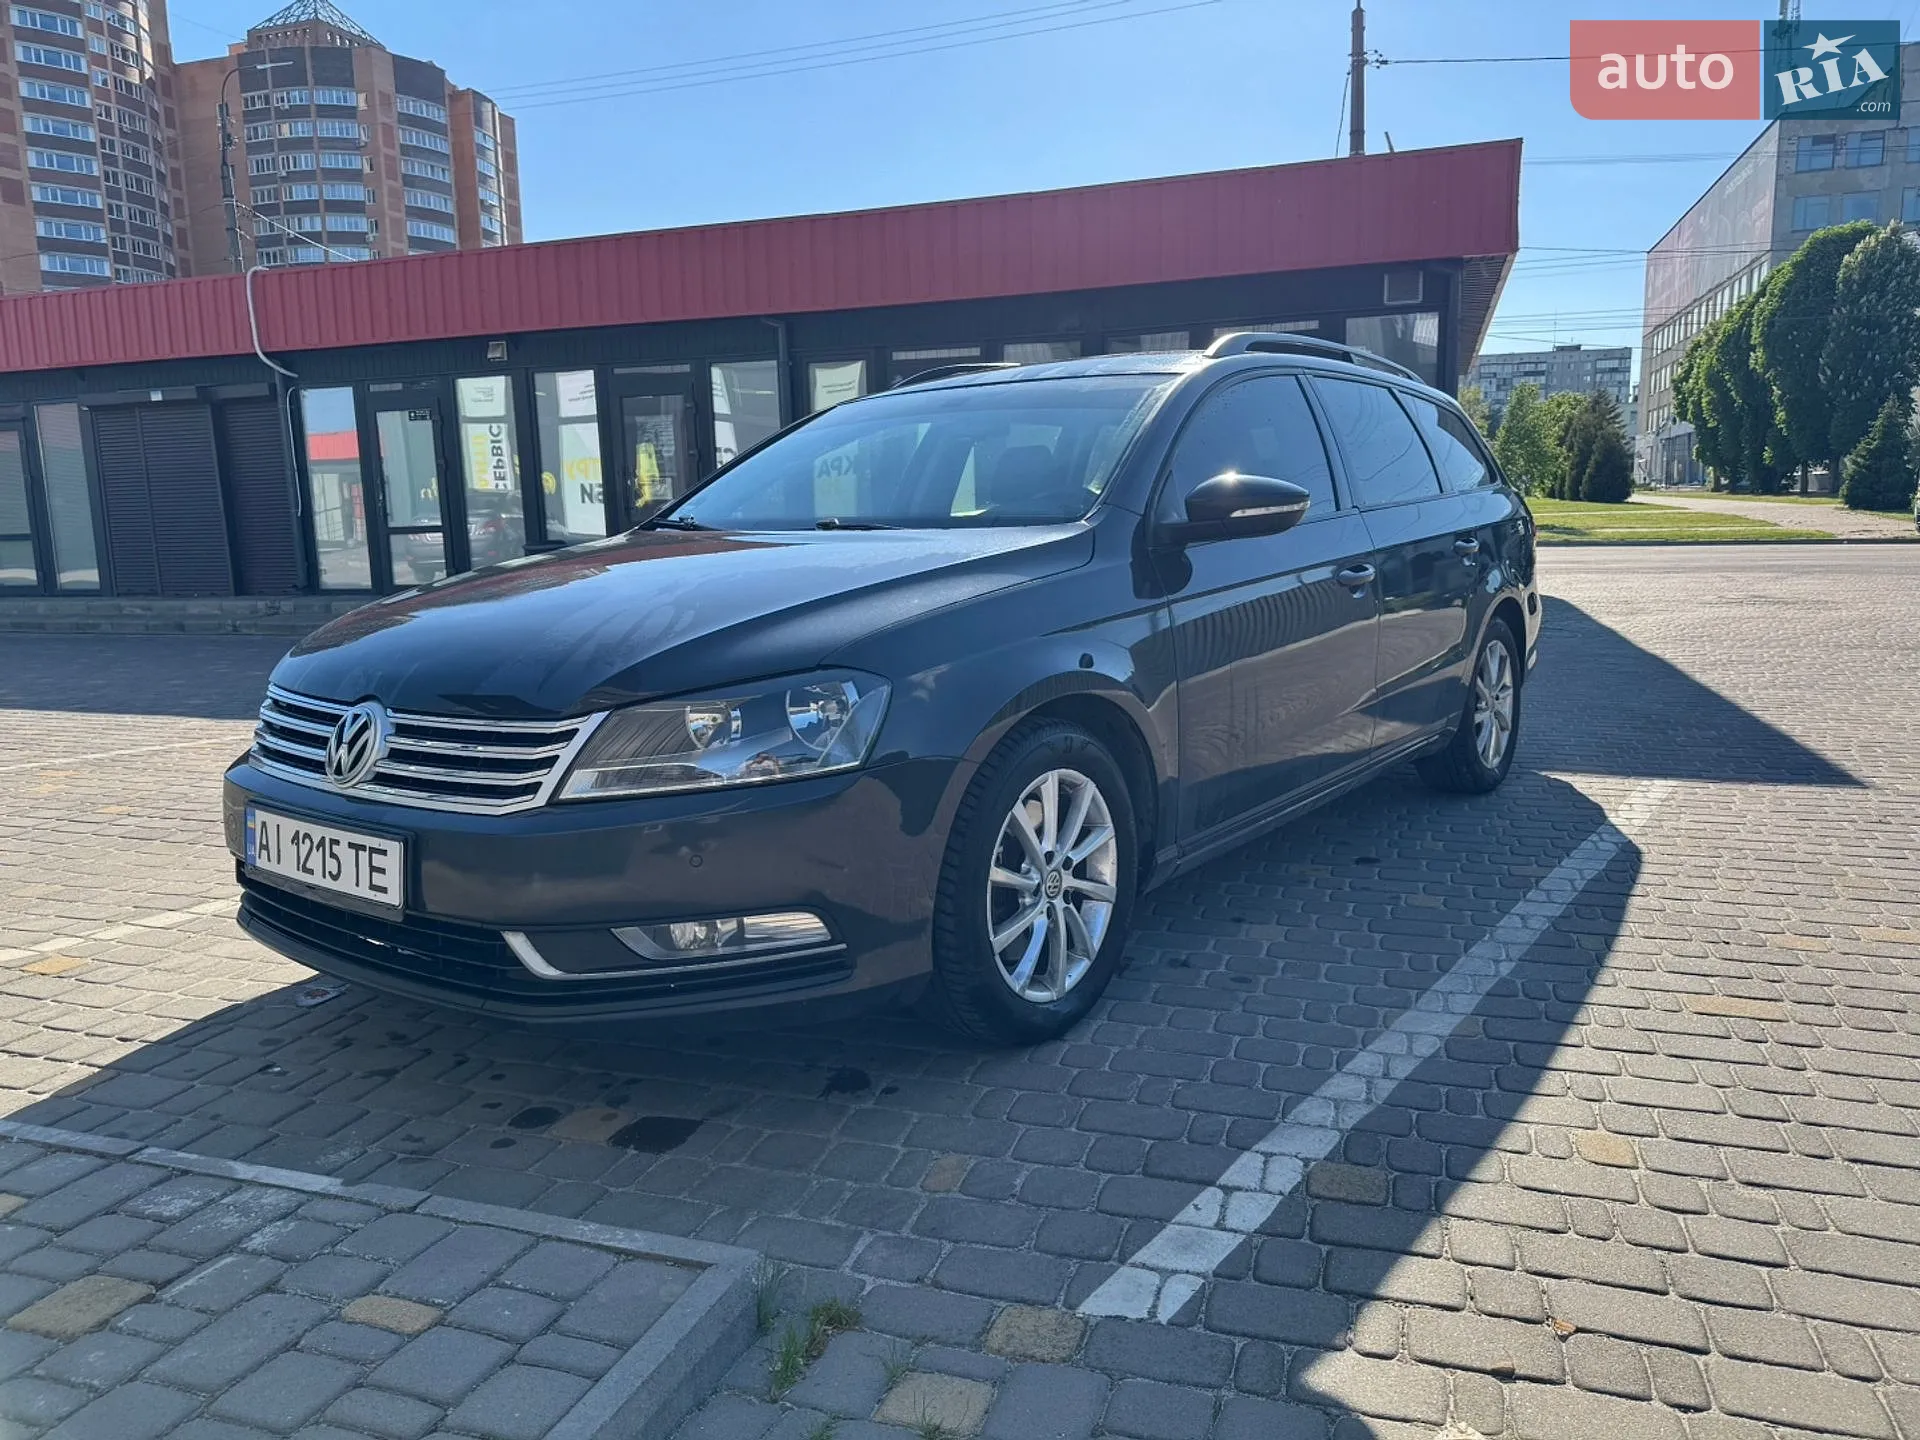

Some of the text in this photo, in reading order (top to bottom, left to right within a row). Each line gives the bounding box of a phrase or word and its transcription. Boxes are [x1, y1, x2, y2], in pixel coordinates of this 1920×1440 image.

[258, 820, 388, 894] AI 1215 TE
